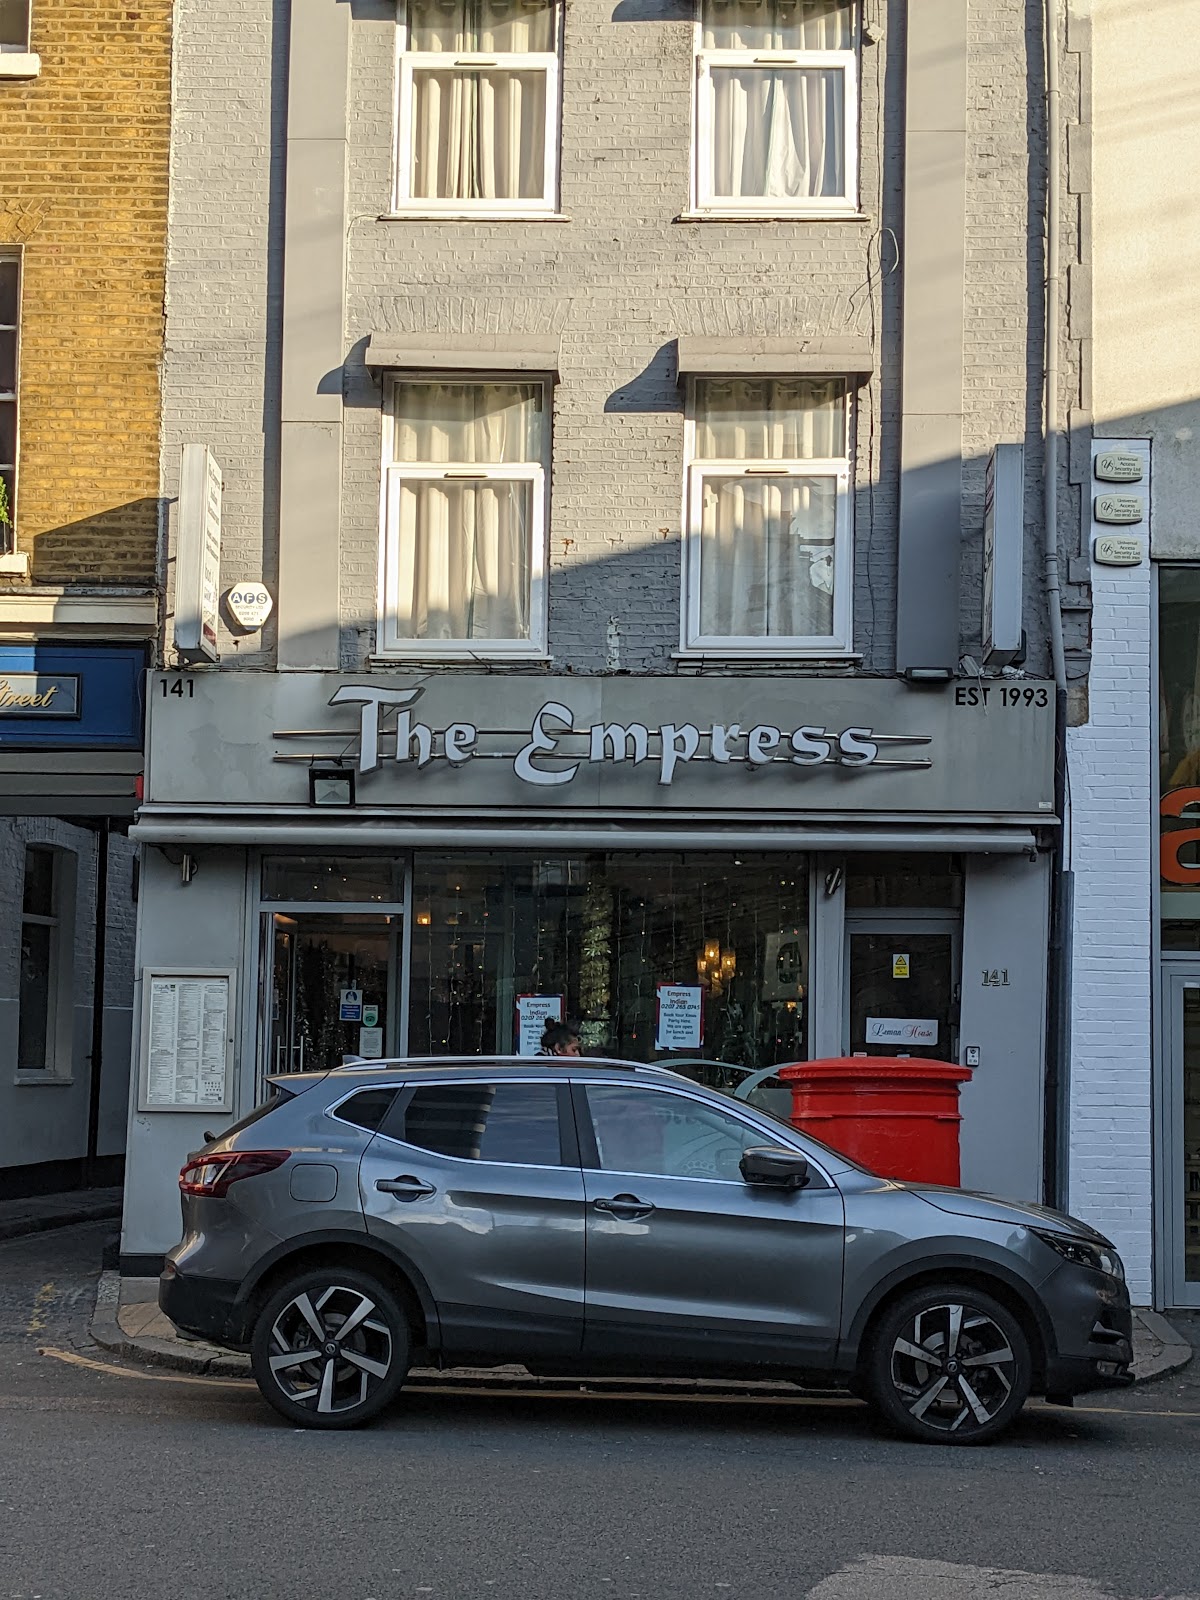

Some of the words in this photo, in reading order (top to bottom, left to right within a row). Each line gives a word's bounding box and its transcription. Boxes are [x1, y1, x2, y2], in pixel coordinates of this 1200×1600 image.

[231, 592, 268, 604] AFS
[160, 678, 194, 698] 141
[955, 687, 990, 706] EST
[1000, 688, 1048, 707] 1993
[328, 684, 478, 775] The
[513, 700, 879, 786] Empress
[982, 968, 1010, 986] 141
[903, 1025, 933, 1038] House
